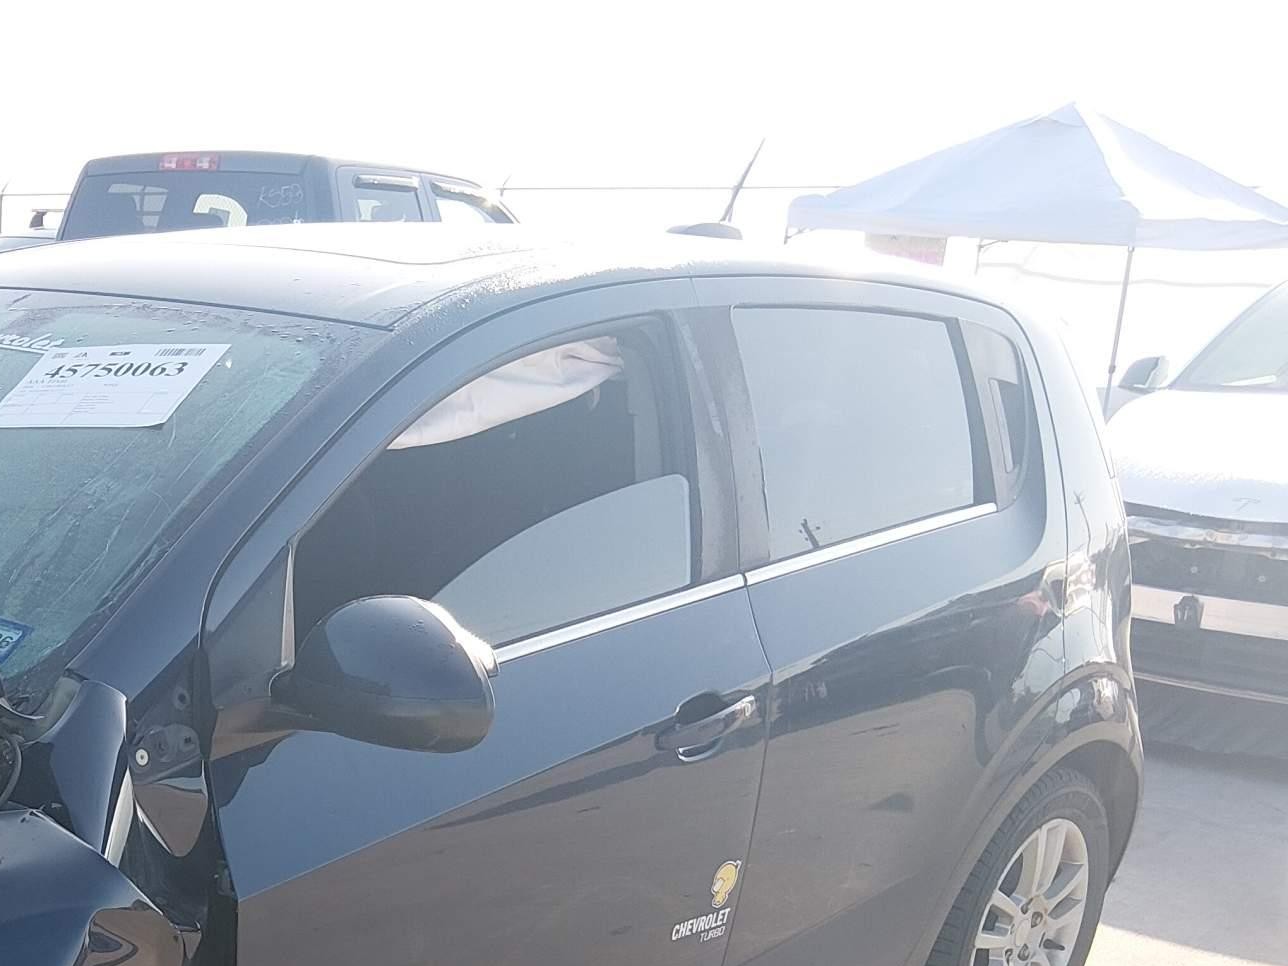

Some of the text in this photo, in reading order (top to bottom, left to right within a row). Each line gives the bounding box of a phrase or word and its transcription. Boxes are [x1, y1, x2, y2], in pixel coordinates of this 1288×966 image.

[45, 361, 189, 379] 45750063
[671, 907, 731, 941] CHEVROLET
[699, 926, 725, 942] TURBO
